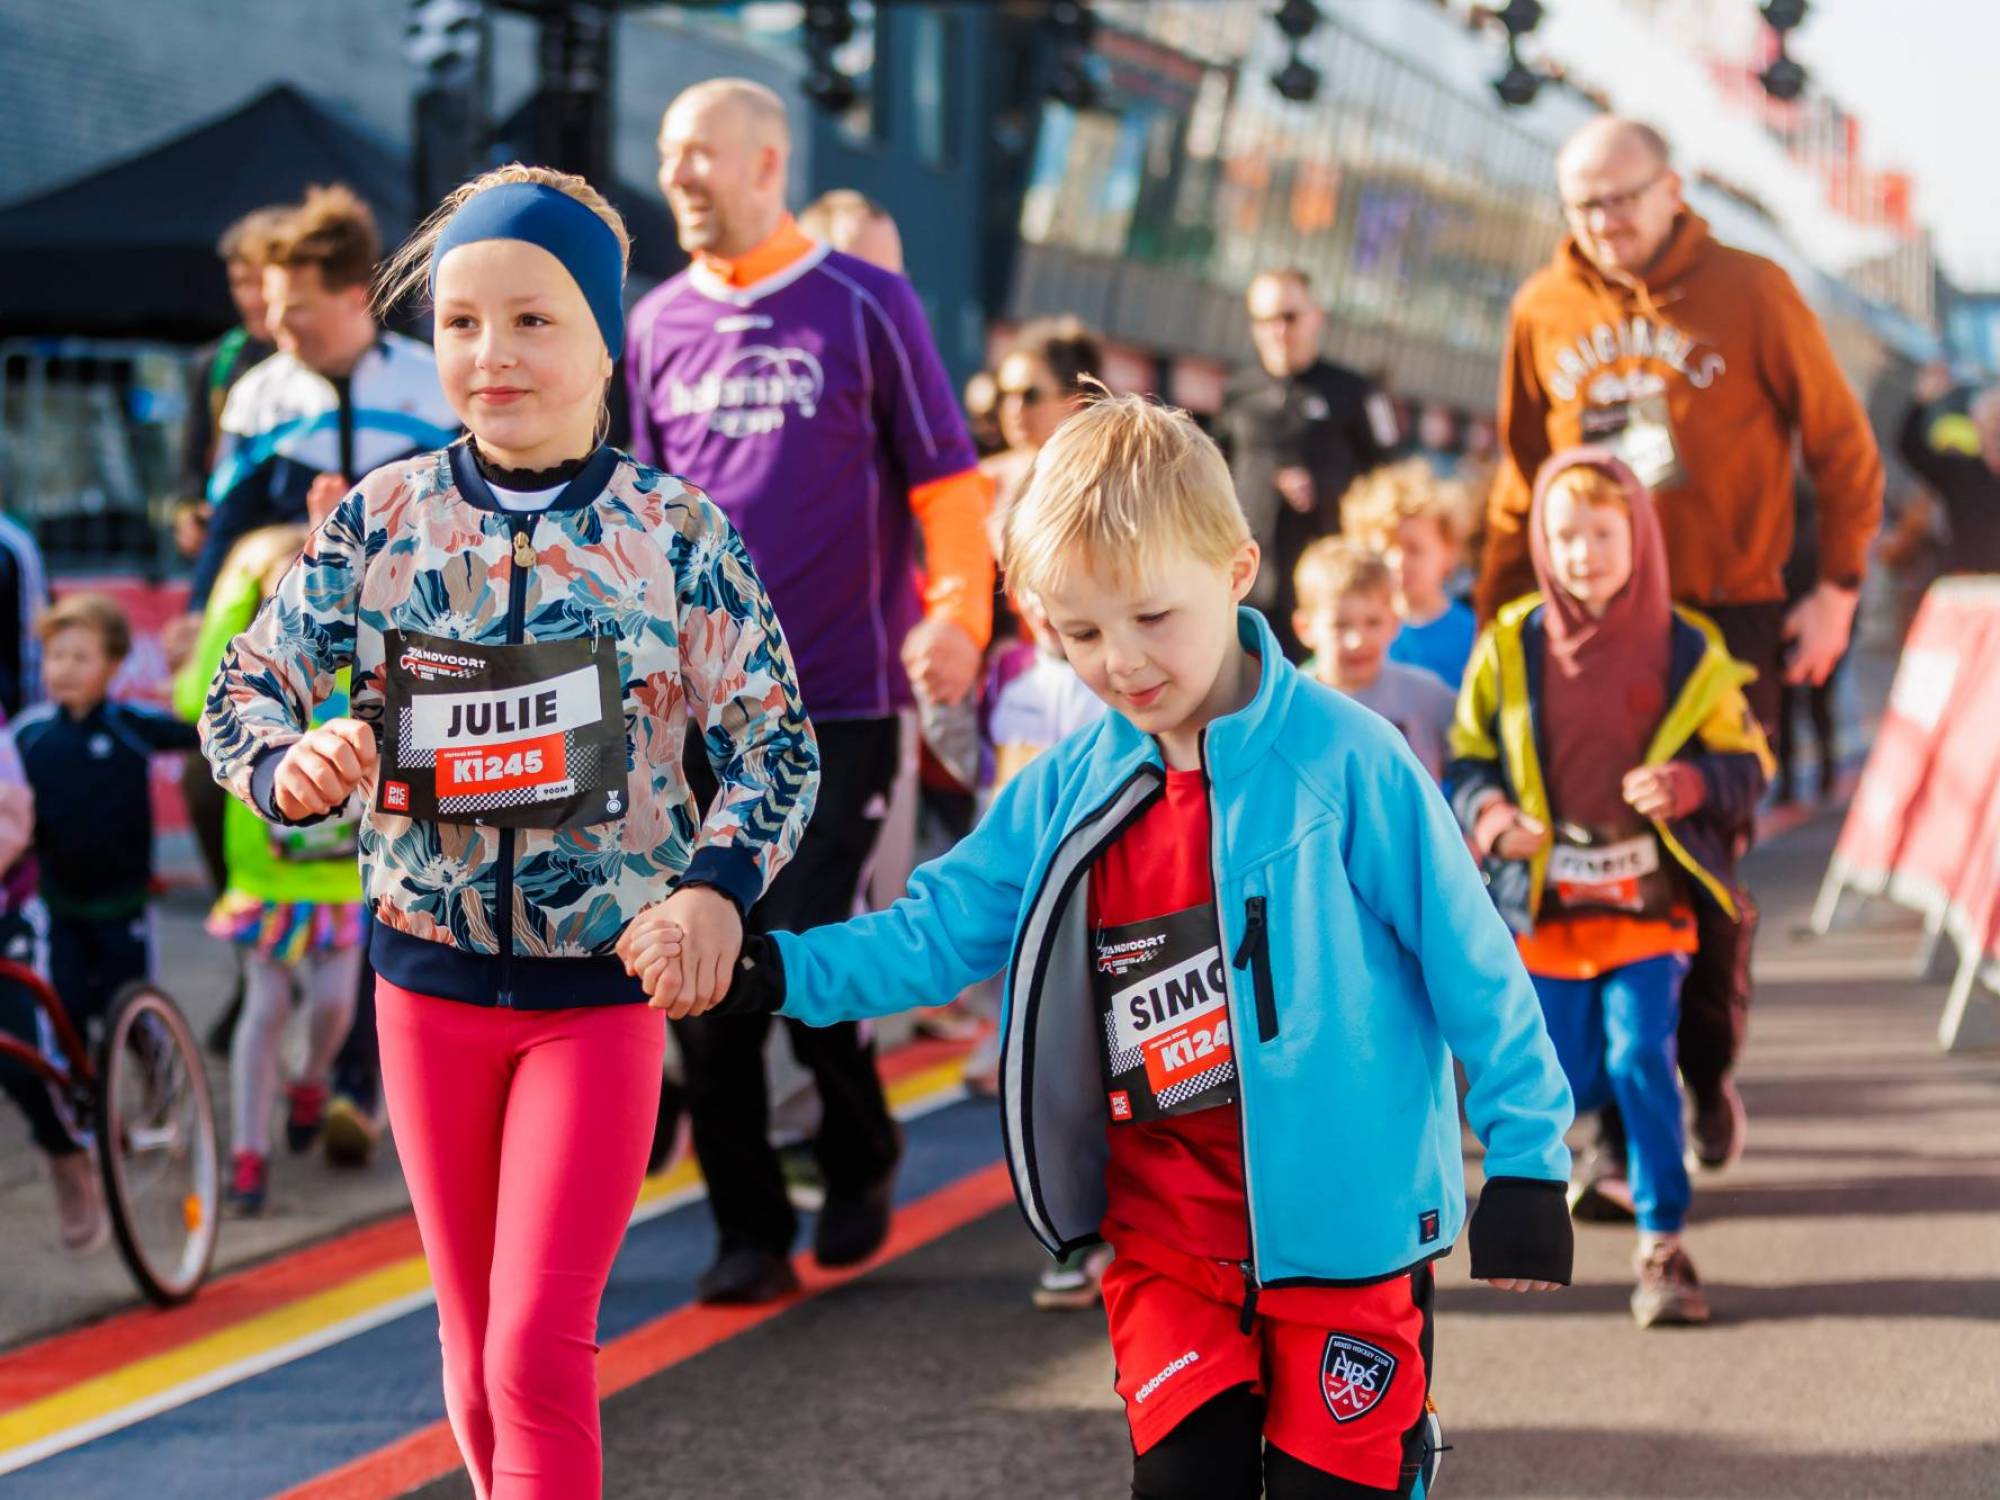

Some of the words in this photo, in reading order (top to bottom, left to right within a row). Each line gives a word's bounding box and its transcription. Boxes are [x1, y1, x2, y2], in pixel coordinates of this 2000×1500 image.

[406, 646, 486, 669] ZANDVOORT
[447, 689, 558, 738] JULIE
[453, 749, 544, 783] K1245
[543, 785, 568, 796] 900M
